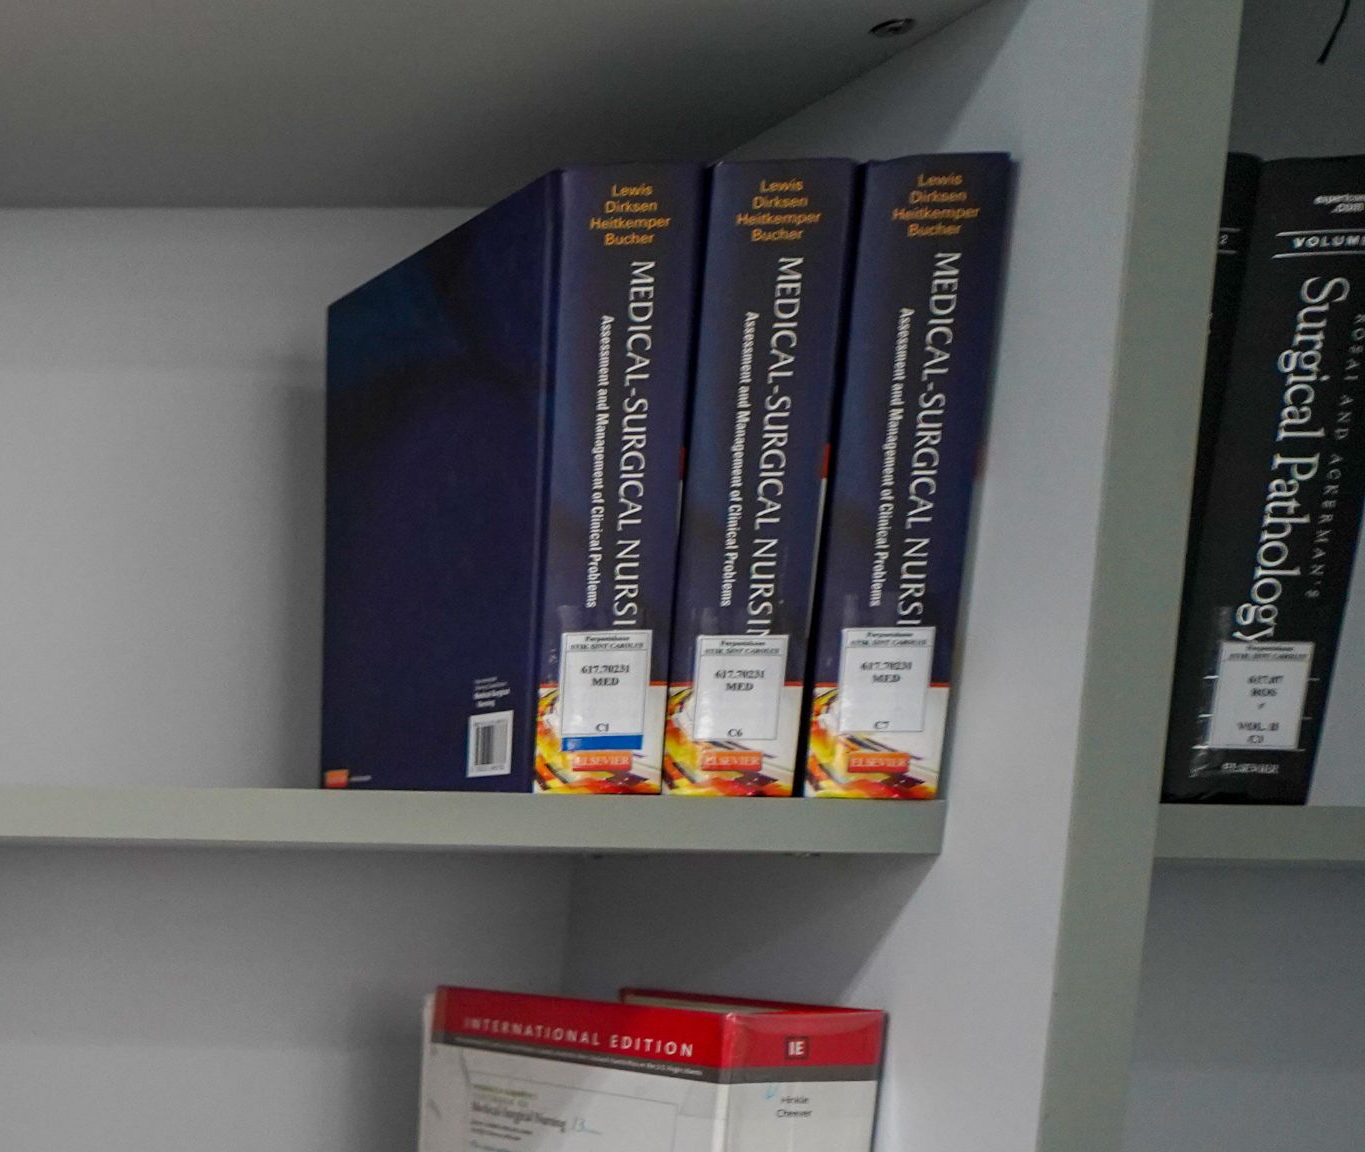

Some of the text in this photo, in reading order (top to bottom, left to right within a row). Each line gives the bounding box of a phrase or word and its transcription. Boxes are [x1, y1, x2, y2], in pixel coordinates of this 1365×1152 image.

[604, 200, 658, 214] Dirksen
[612, 182, 653, 197] Lewis
[589, 216, 671, 229] Heitkemper
[604, 232, 655, 245] Bucher
[1275, 276, 1351, 442] Surgical
[616, 260, 656, 531] MEDICAL-SURGICAL
[754, 255, 804, 531] MEDICAL-SURGICAL
[905, 250, 963, 530] MEDICAL-SURGICAL
[1334, 395, 1354, 441] AND
[585, 315, 615, 608] Assessment and Management of Clinical Problems
[1232, 452, 1322, 641] Pathology
[1306, 453, 1343, 598] ACKERMAN'S
[581, 665, 631, 675] 617.70231
[591, 677, 619, 687] MED
[463, 1018, 600, 1046] INTERNATIONAL
[608, 1034, 694, 1058] EDITION
